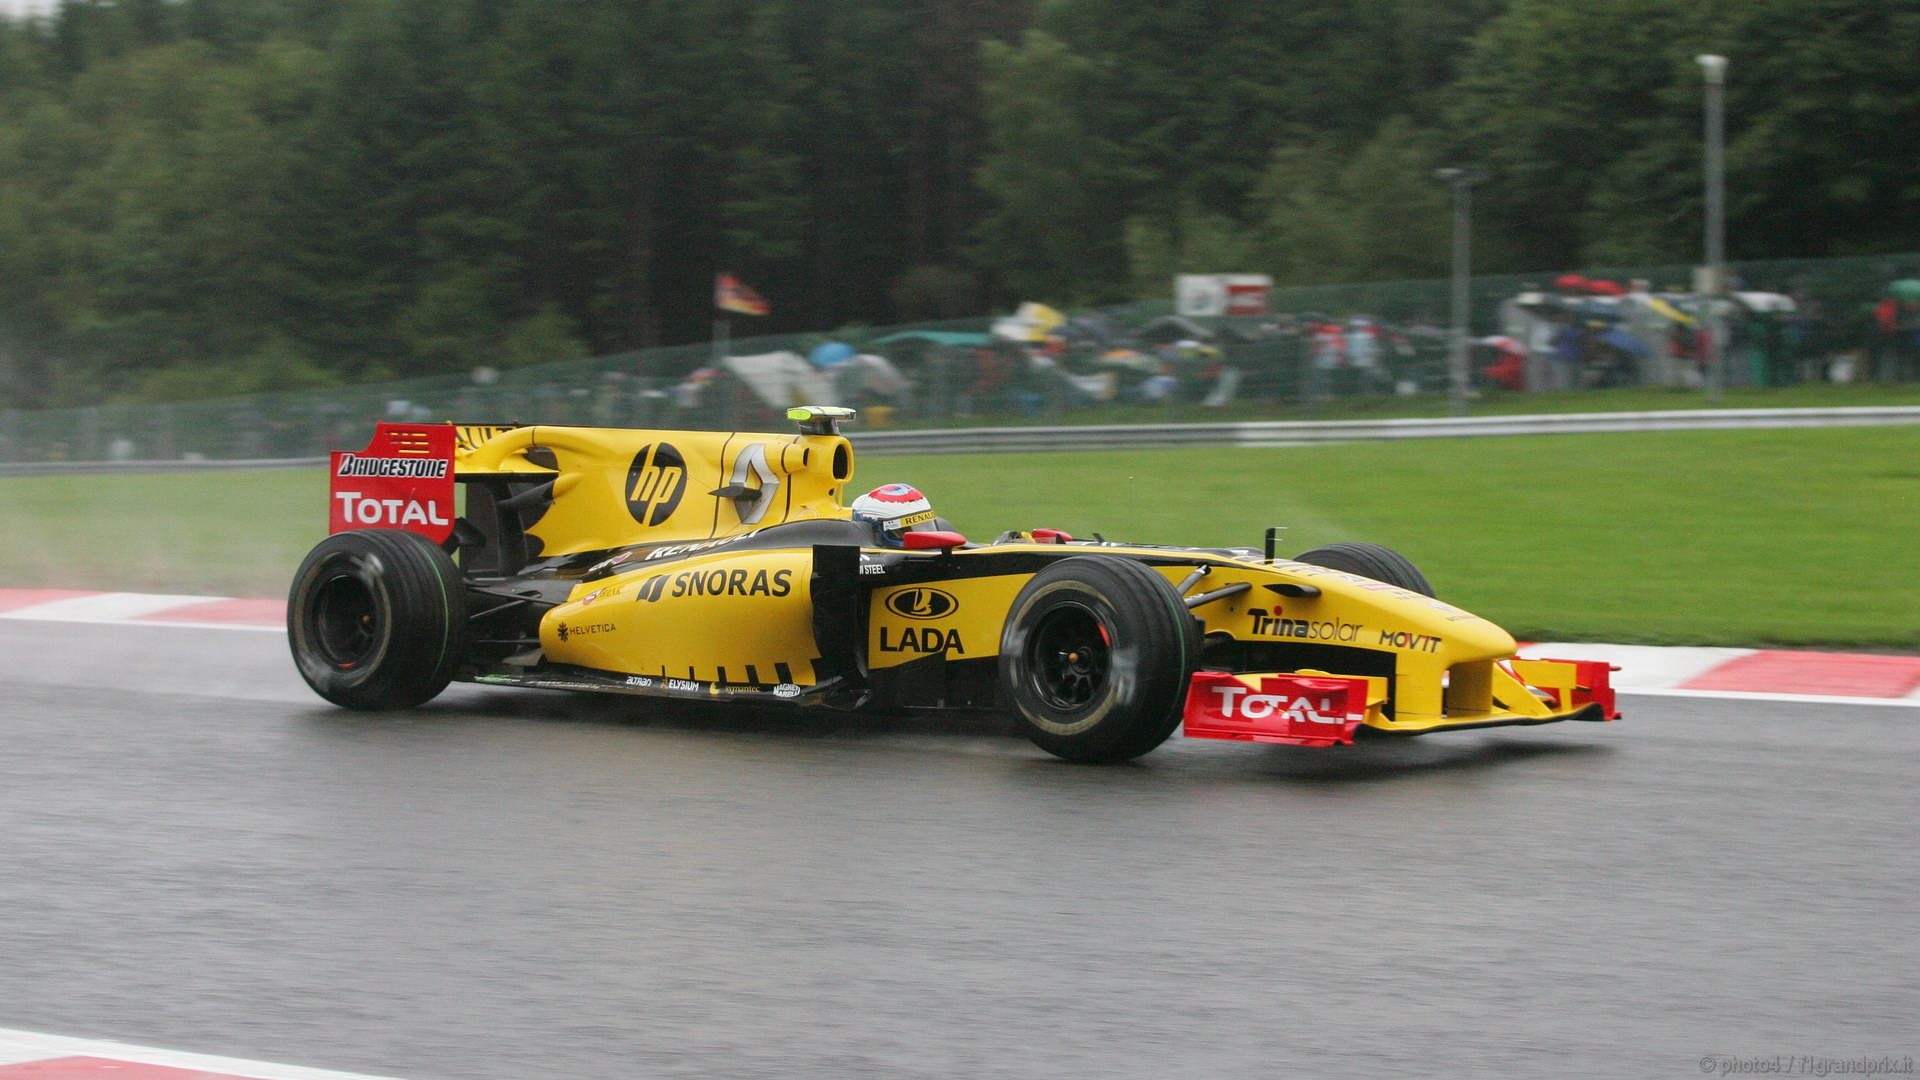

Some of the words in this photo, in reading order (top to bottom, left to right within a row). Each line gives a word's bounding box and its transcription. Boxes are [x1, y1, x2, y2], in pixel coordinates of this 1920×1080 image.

[337, 453, 449, 478] BRIDGESTONE
[335, 492, 449, 526] TOTAL
[671, 568, 793, 598] SNORAS
[864, 564, 886, 575] STEEL
[569, 622, 617, 636] HELVETICA
[1246, 605, 1364, 643] Trinasolar
[879, 626, 965, 654] LADA
[668, 679, 700, 692] ELYSIUM
[1211, 685, 1364, 725] TOTAL
